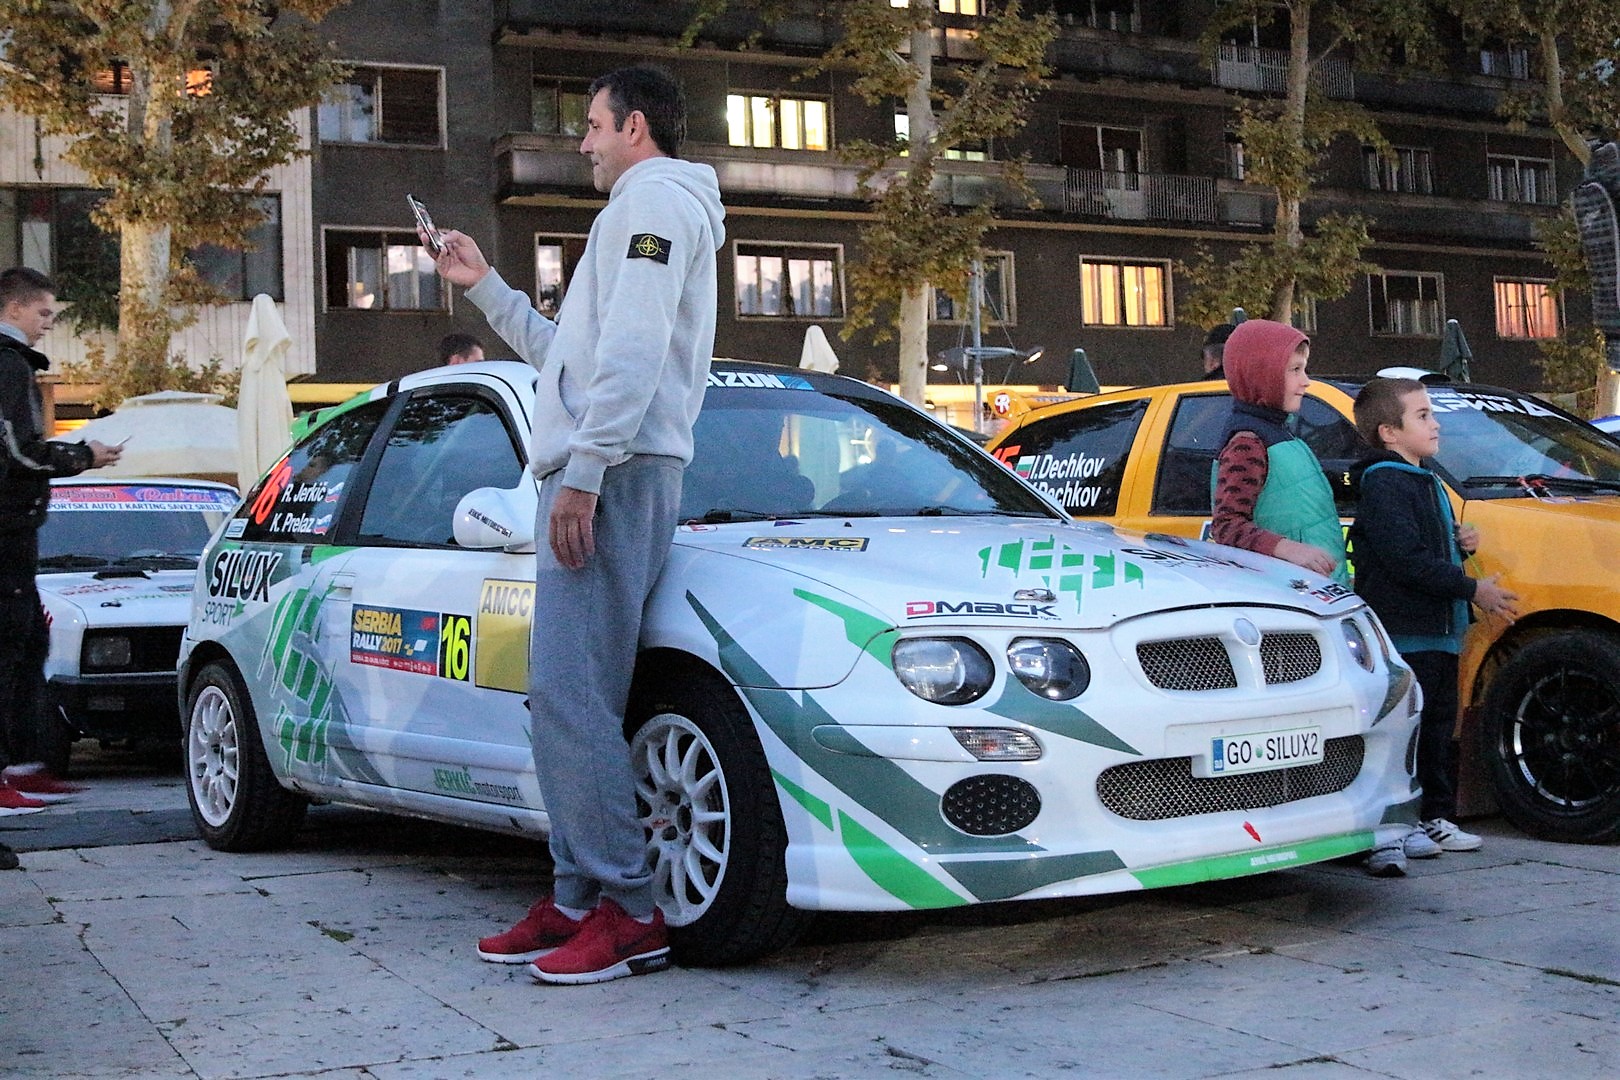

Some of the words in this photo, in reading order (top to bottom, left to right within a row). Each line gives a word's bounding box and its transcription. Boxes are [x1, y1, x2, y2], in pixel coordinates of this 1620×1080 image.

[48, 502, 89, 511] PORTSKI
[92, 502, 116, 511] AUTO
[125, 502, 166, 511] KARTING
[209, 550, 282, 604] SILUX
[202, 601, 236, 627] SPORT
[481, 585, 531, 617] AMCC
[353, 608, 402, 636] SERBIA
[352, 632, 383, 651] RALLY
[380, 637, 403, 654] 2017
[442, 615, 470, 681] 16
[1227, 740, 1252, 765] GO
[1266, 732, 1319, 761] SILUX2
